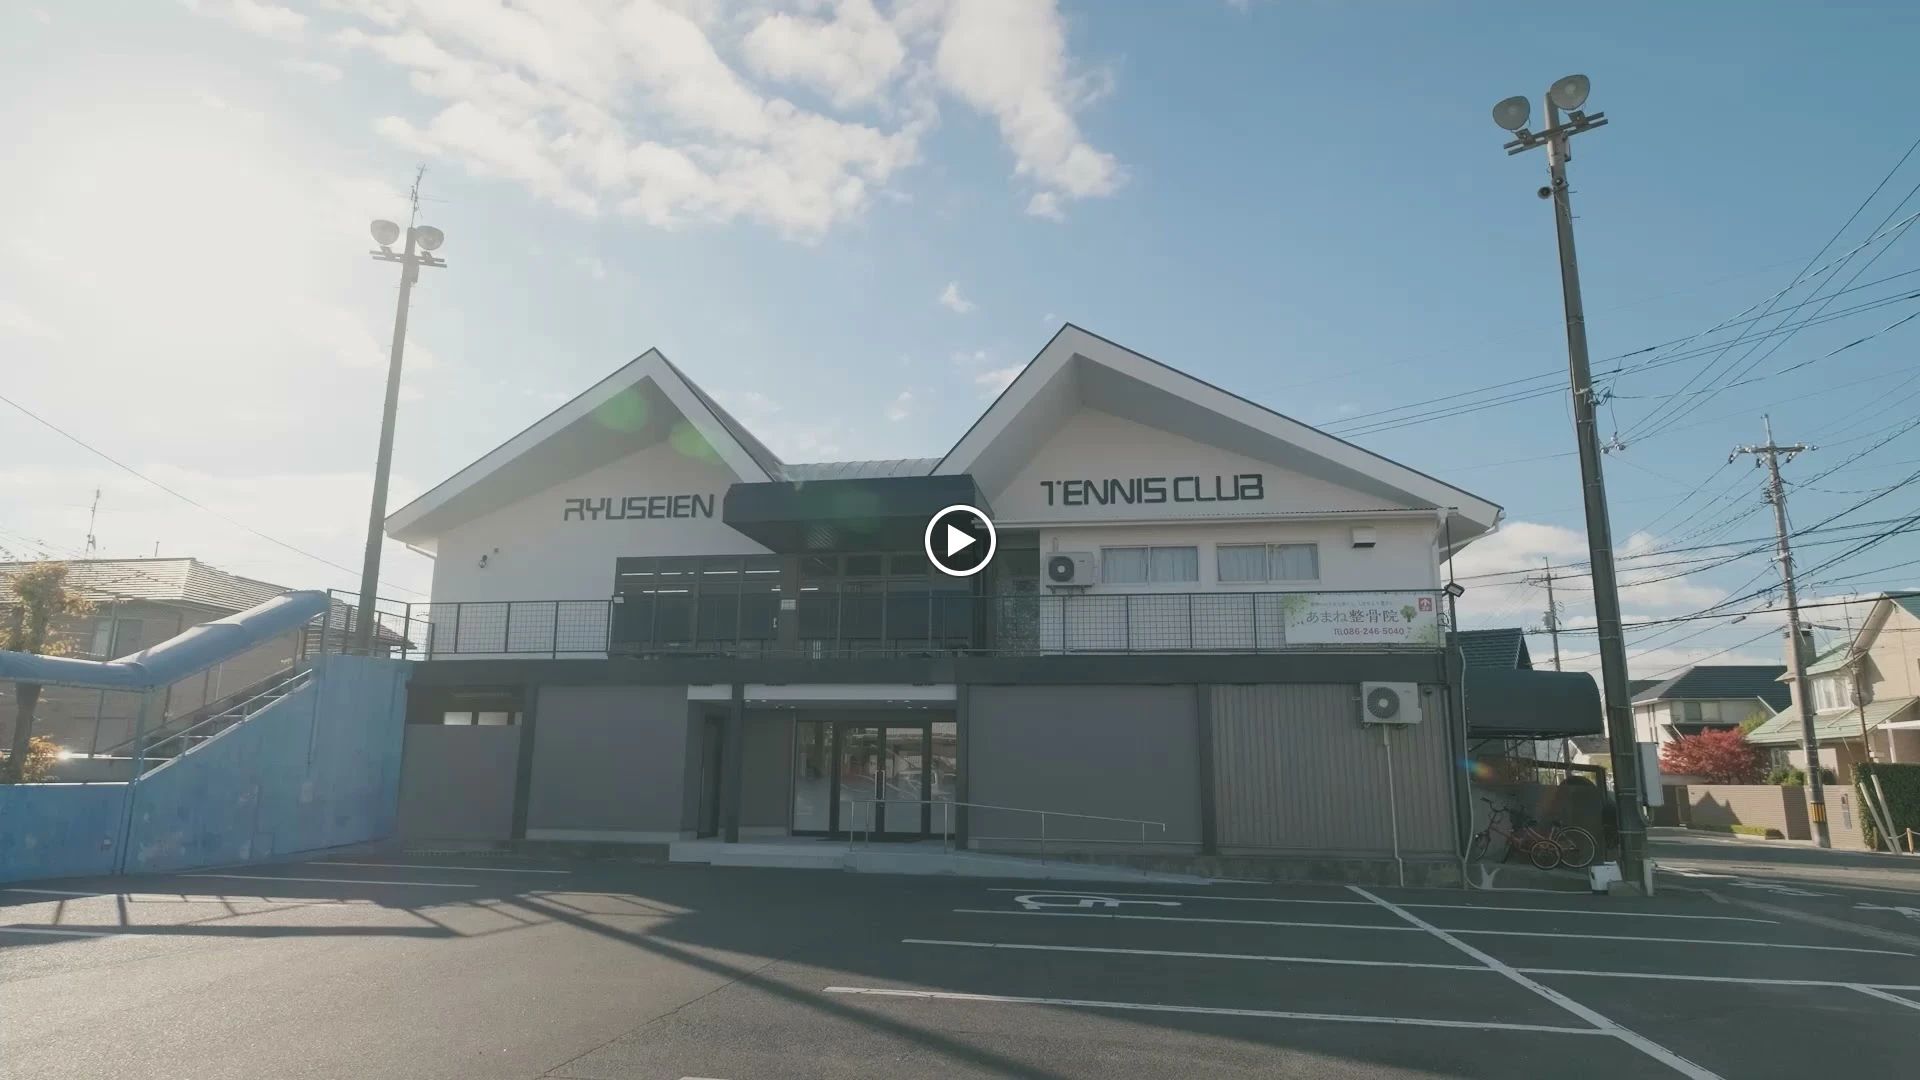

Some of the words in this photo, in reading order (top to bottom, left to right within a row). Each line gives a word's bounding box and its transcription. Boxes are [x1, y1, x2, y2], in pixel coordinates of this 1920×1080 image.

[1040, 477, 1167, 506] TENNIS
[1173, 474, 1265, 502] CLUB
[563, 494, 715, 521] RYUSEIEN
[1306, 608, 1400, 624] あまね整骨院
